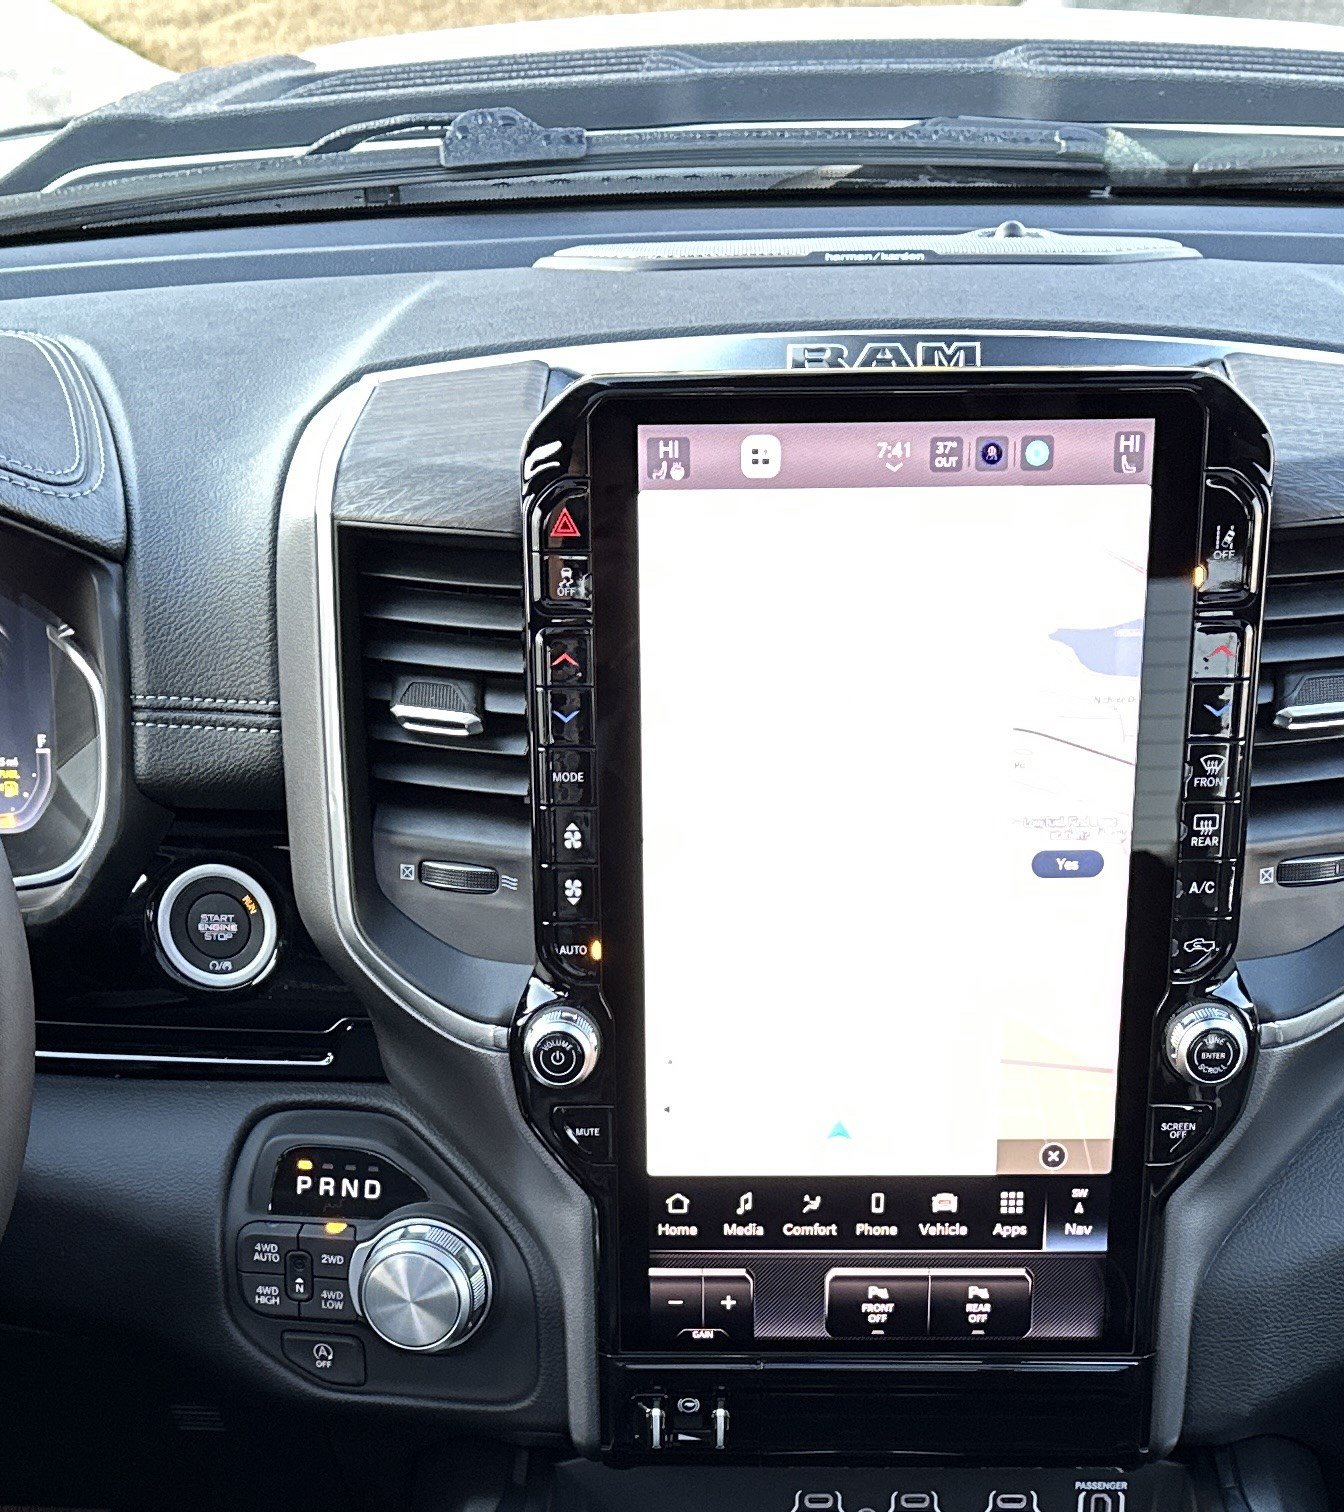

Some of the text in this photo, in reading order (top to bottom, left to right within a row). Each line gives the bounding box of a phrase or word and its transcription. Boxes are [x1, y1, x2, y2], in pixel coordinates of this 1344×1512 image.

[786, 341, 981, 368] RAM
[1119, 434, 1140, 453] HI
[658, 440, 679, 459] HI
[877, 441, 911, 459] 7:41
[935, 457, 958, 468] OUT
[1213, 550, 1235, 560] OFF
[557, 587, 576, 597] OFF
[553, 772, 584, 783] MODE
[1193, 777, 1229, 787] FRONT
[1190, 836, 1219, 847] REAR
[1056, 858, 1079, 871] Yes
[1189, 881, 1215, 894] A/C
[201, 914, 234, 922] START
[198, 923, 237, 931] ENGINE
[204, 932, 233, 940] STOP
[559, 945, 587, 955] AUTO
[541, 1039, 573, 1052] VOLUME
[1198, 1063, 1228, 1074] SCROLL
[1161, 1122, 1196, 1131] SCREEN
[575, 1128, 600, 1136] MUTE
[1170, 1131, 1187, 1139] OFF
[1072, 1189, 1089, 1198] SW
[658, 1223, 698, 1236] Home
[723, 1223, 764, 1236] Media
[783, 1223, 837, 1236] Comfort
[855, 1223, 898, 1236] Phone
[918, 1223, 968, 1236] Vehicle
[992, 1223, 1027, 1239] Apps
[1064, 1223, 1092, 1236] Nav
[254, 1243, 278, 1253] 4WD
[253, 1253, 280, 1263] AUTO
[321, 1255, 344, 1265] 2WD
[256, 1286, 279, 1296] 4WD
[295, 1284, 303, 1293] N
[256, 1295, 280, 1305] HIGH
[321, 1290, 344, 1300] 4WD
[321, 1300, 344, 1310] LOW
[861, 1303, 895, 1313] FRONT
[965, 1303, 991, 1313] REAR
[868, 1314, 887, 1323] OFF
[968, 1314, 988, 1323] OFF
[692, 1330, 714, 1339] GAIN
[316, 1360, 332, 1368] OFF
[1075, 1481, 1128, 1490] PASSENGER
